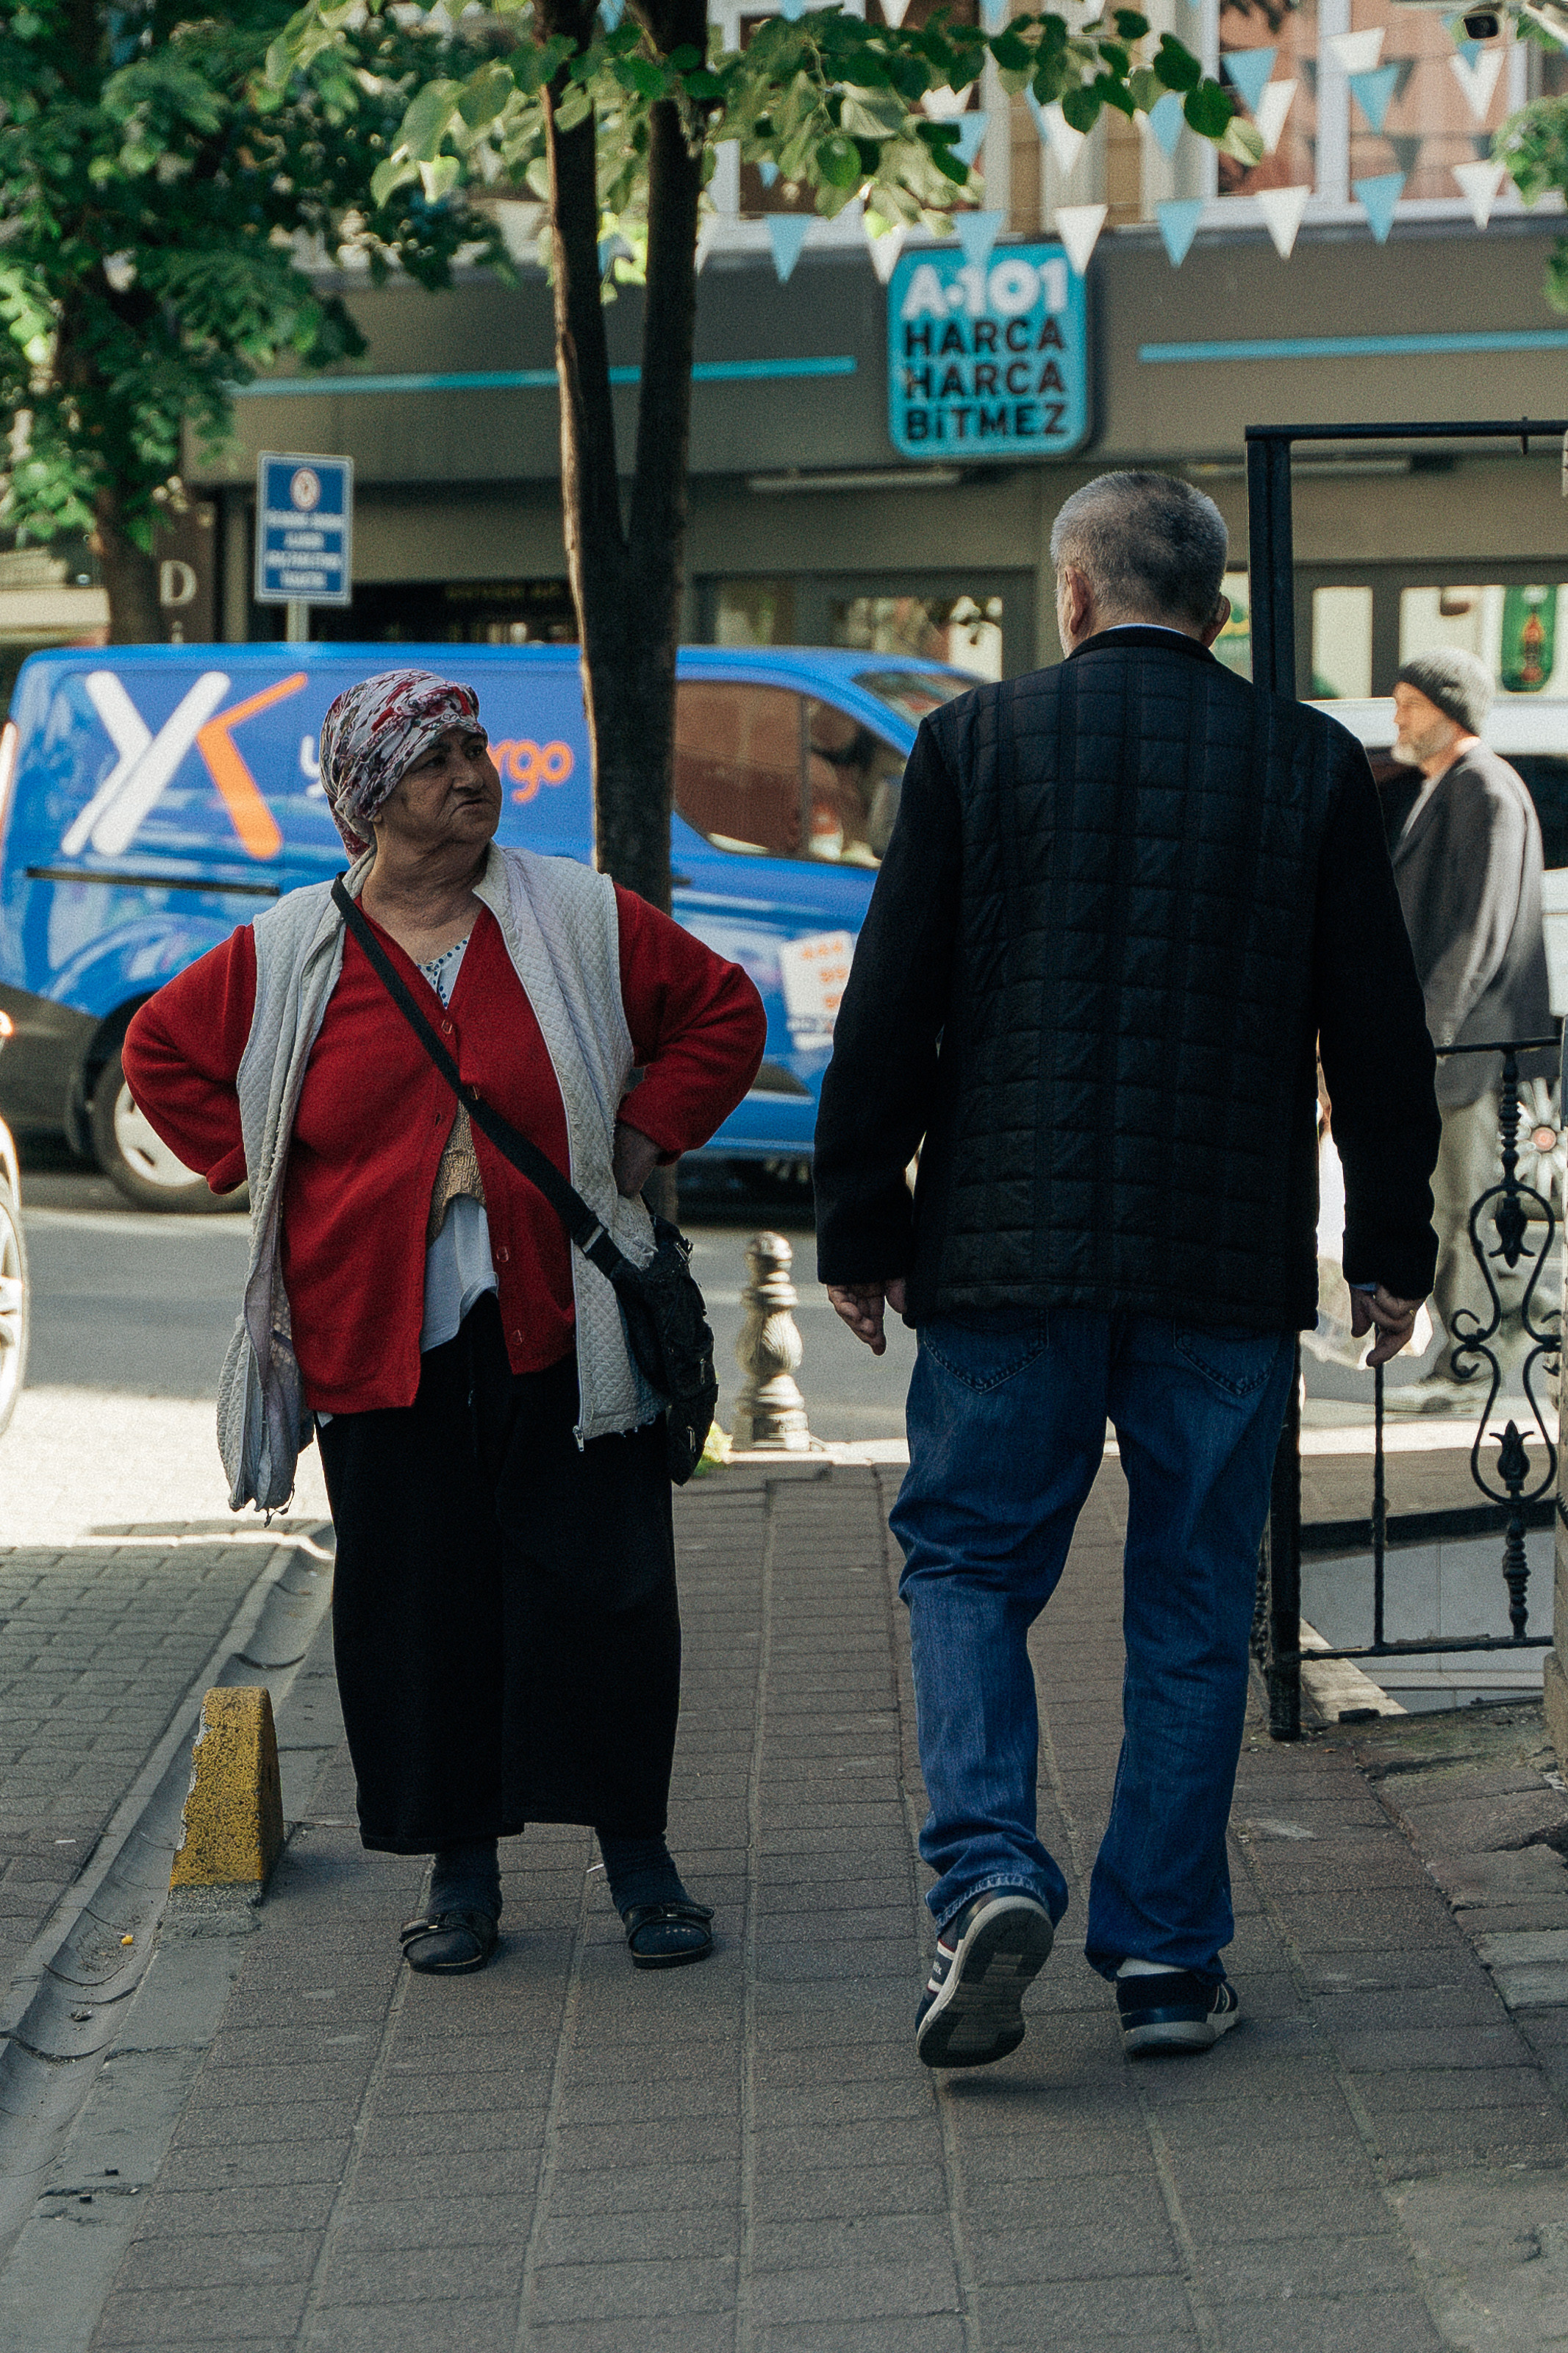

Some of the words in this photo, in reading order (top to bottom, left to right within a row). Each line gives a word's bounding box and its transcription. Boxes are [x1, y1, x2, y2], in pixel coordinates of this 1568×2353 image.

[906, 318, 1064, 356] HARCA
[906, 360, 1064, 399] HARCA
[488, 740, 574, 801] rgo
